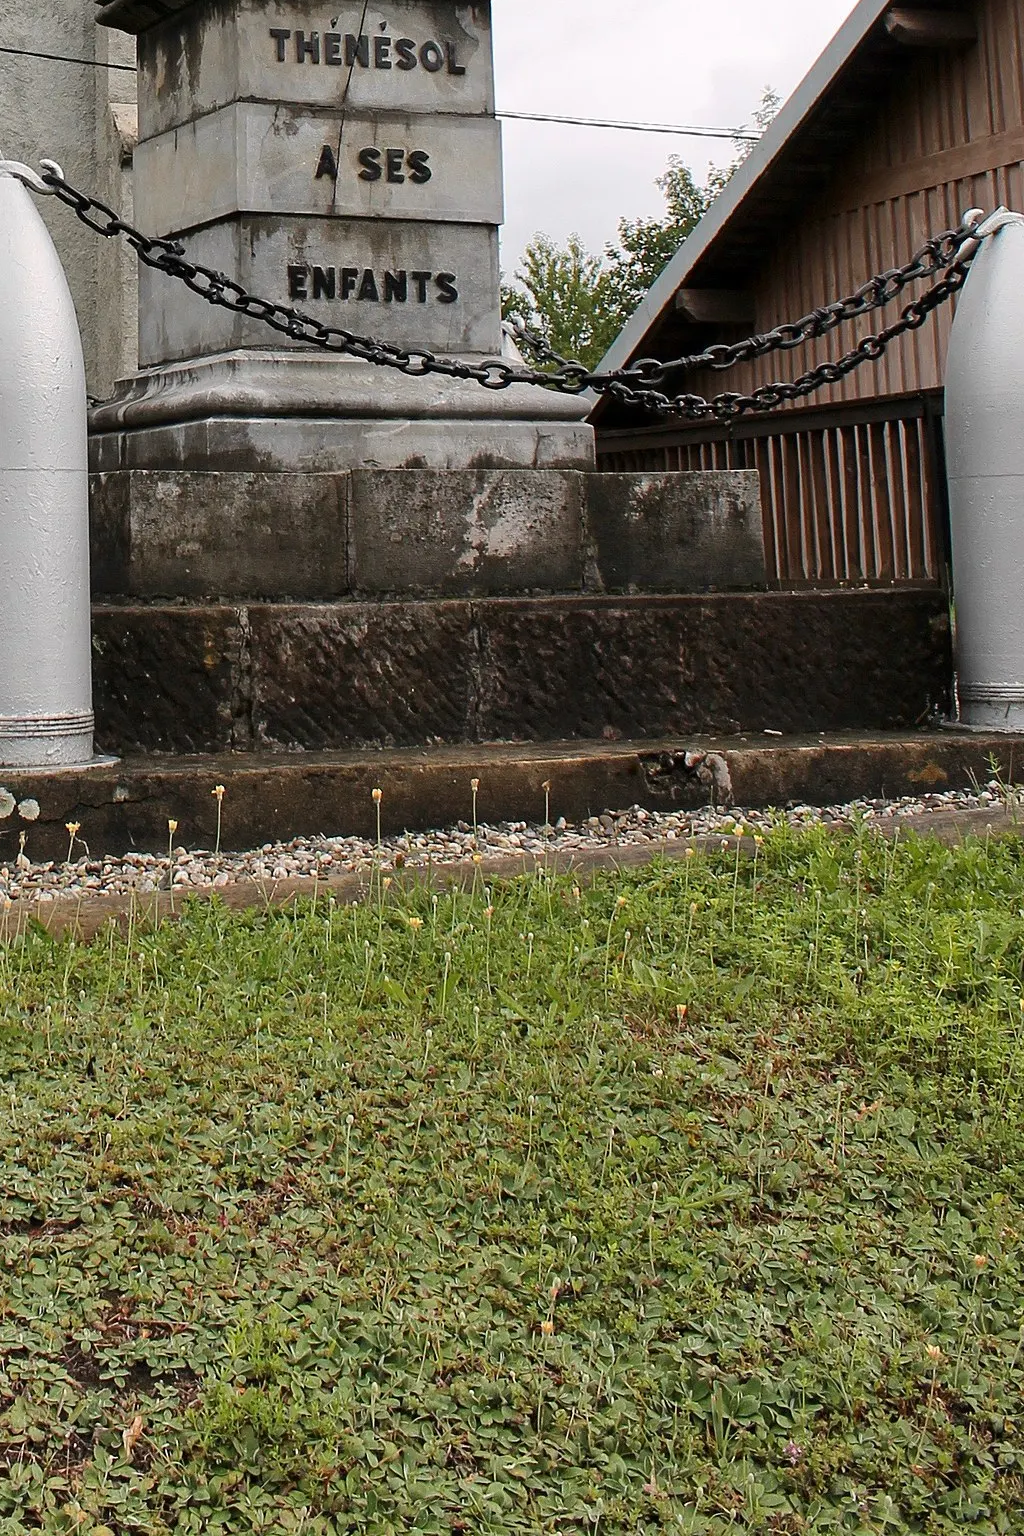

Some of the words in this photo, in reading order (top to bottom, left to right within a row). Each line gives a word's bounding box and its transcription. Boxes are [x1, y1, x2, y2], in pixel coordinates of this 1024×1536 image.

[269, 16, 466, 75] THÉNÉSOL
[315, 144, 339, 181] A
[358, 145, 432, 185] SES
[288, 264, 459, 304] ENFANTS
